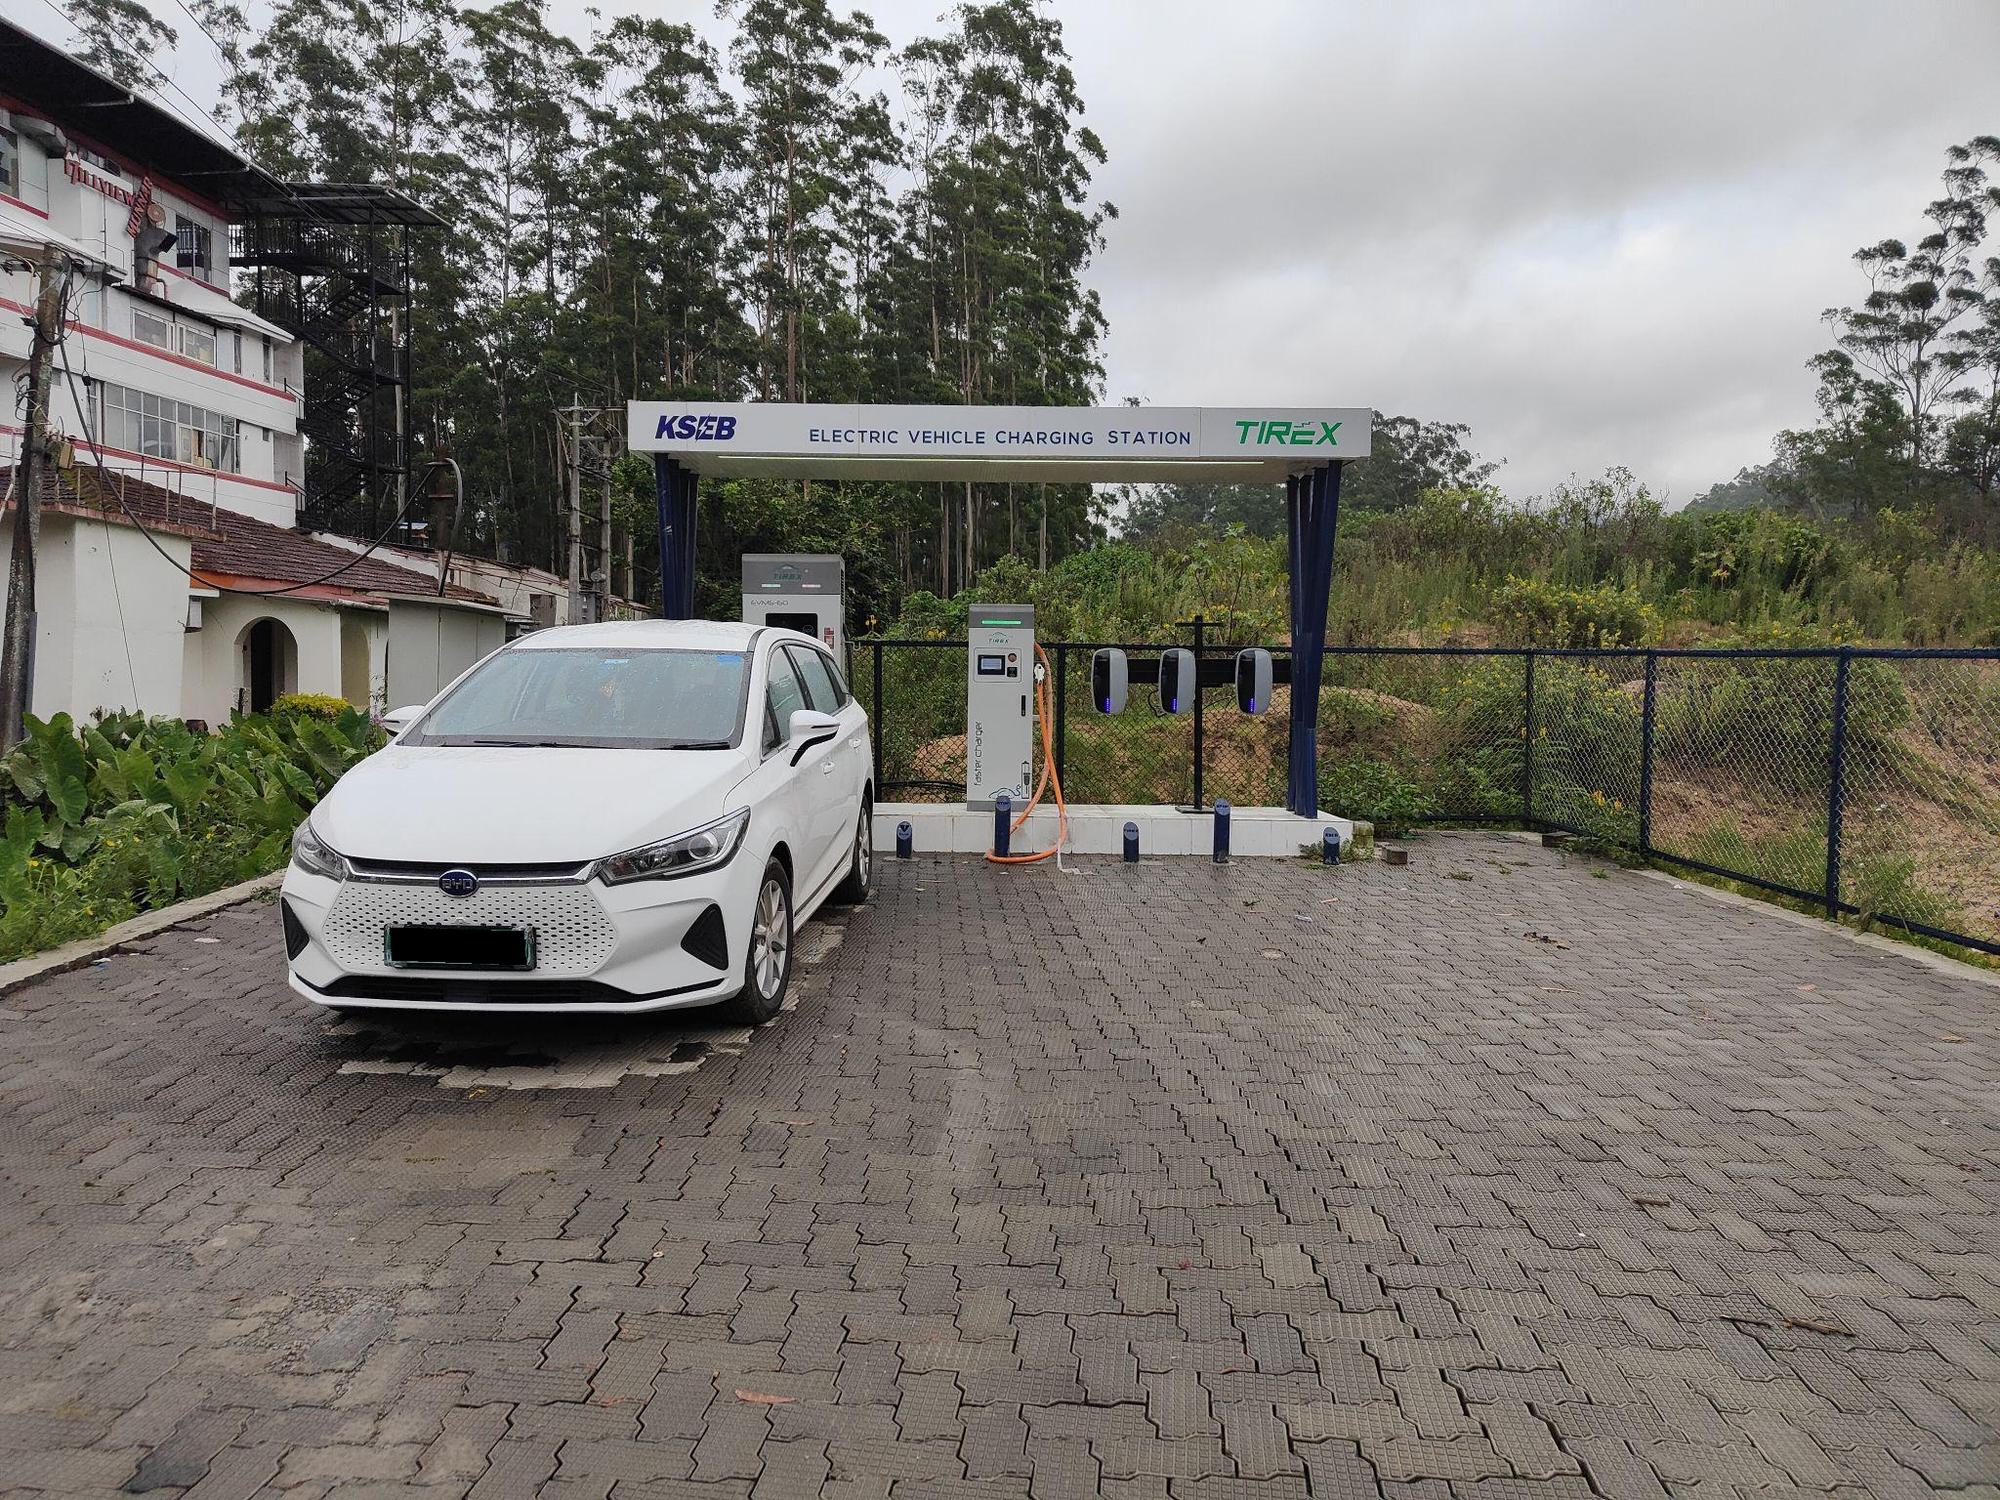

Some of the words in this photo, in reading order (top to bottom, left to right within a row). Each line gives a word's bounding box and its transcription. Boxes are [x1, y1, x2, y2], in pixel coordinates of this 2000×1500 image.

[655, 414, 737, 441] KSEB
[809, 429, 899, 444] ELECTRIC
[908, 430, 986, 444] VEHICLE
[995, 430, 1094, 445] CHARGING
[1107, 430, 1191, 444] STATION
[1235, 420, 1343, 446] TIREX
[974, 721, 984, 758] charger
[442, 878, 473, 890] BYD
